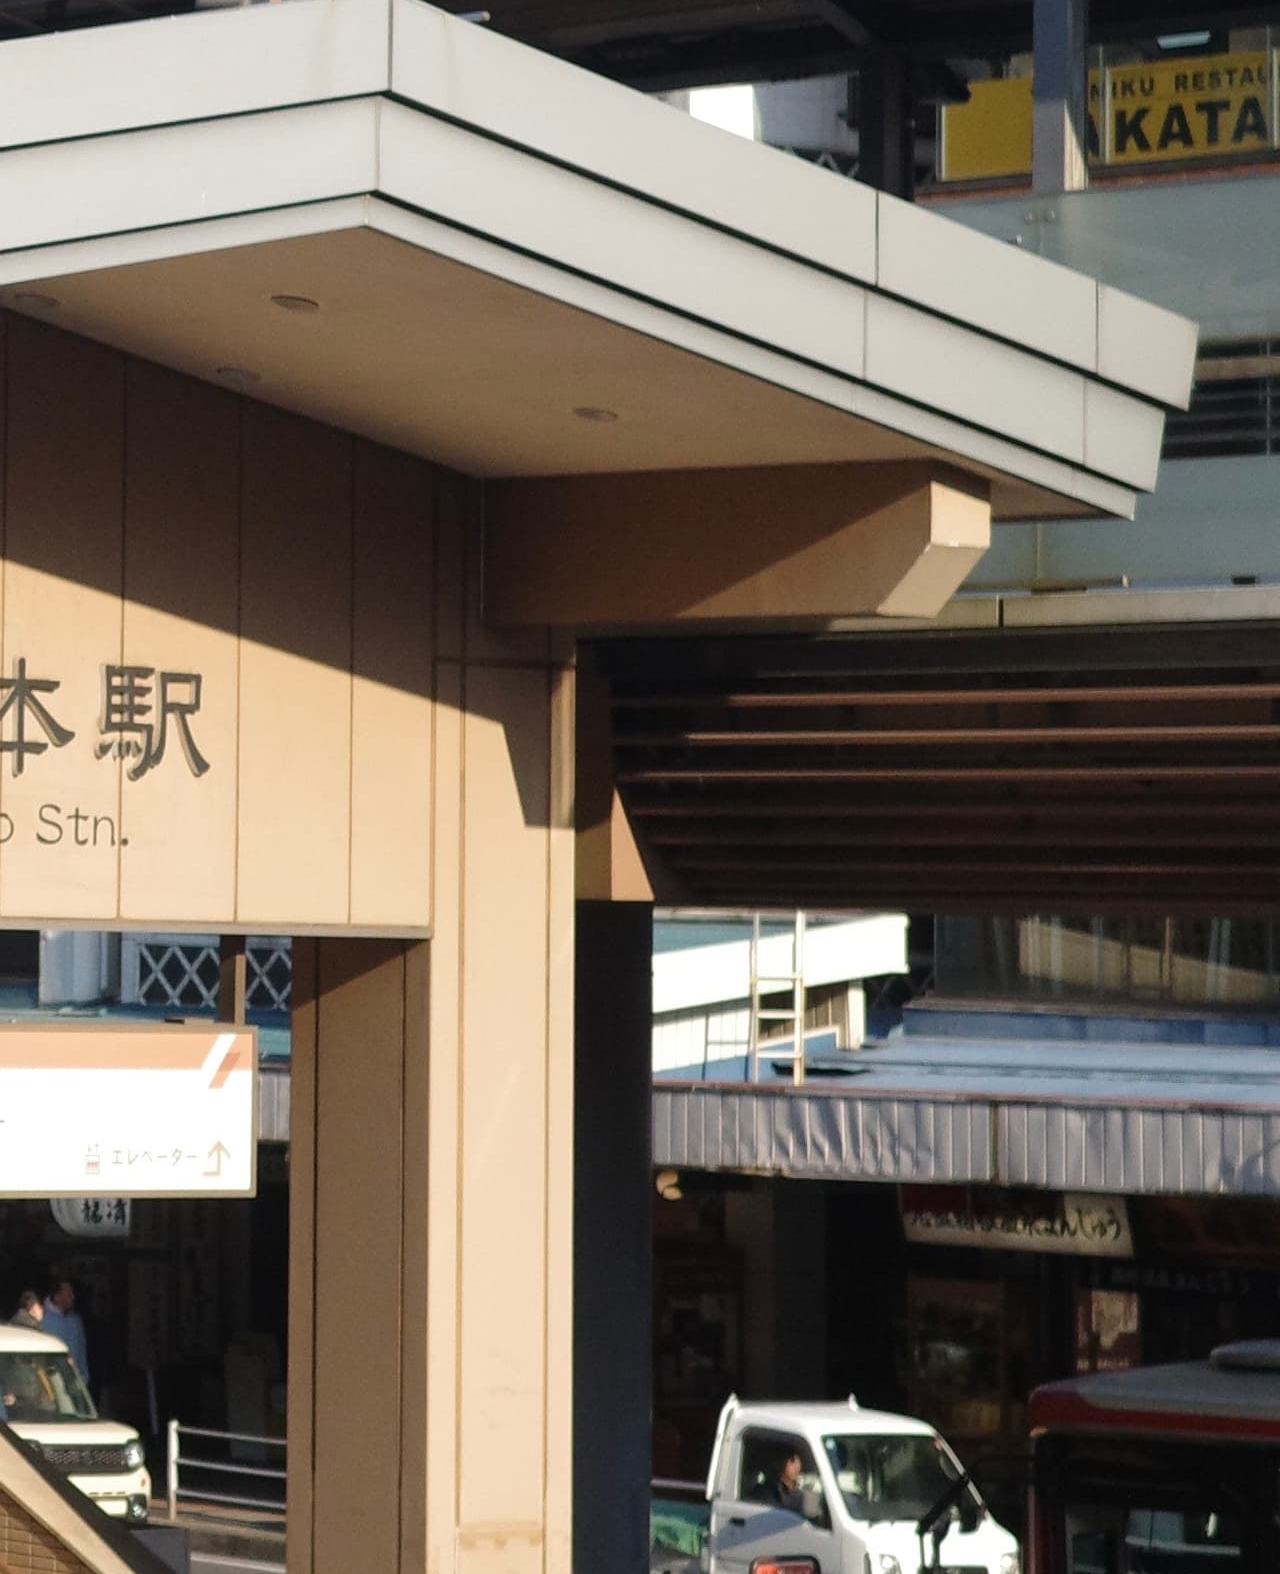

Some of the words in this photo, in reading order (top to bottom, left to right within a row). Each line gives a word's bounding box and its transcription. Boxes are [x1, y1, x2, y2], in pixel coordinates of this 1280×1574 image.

[35, 801, 131, 848] Stn.
[111, 1148, 199, 1167] エレベーター
